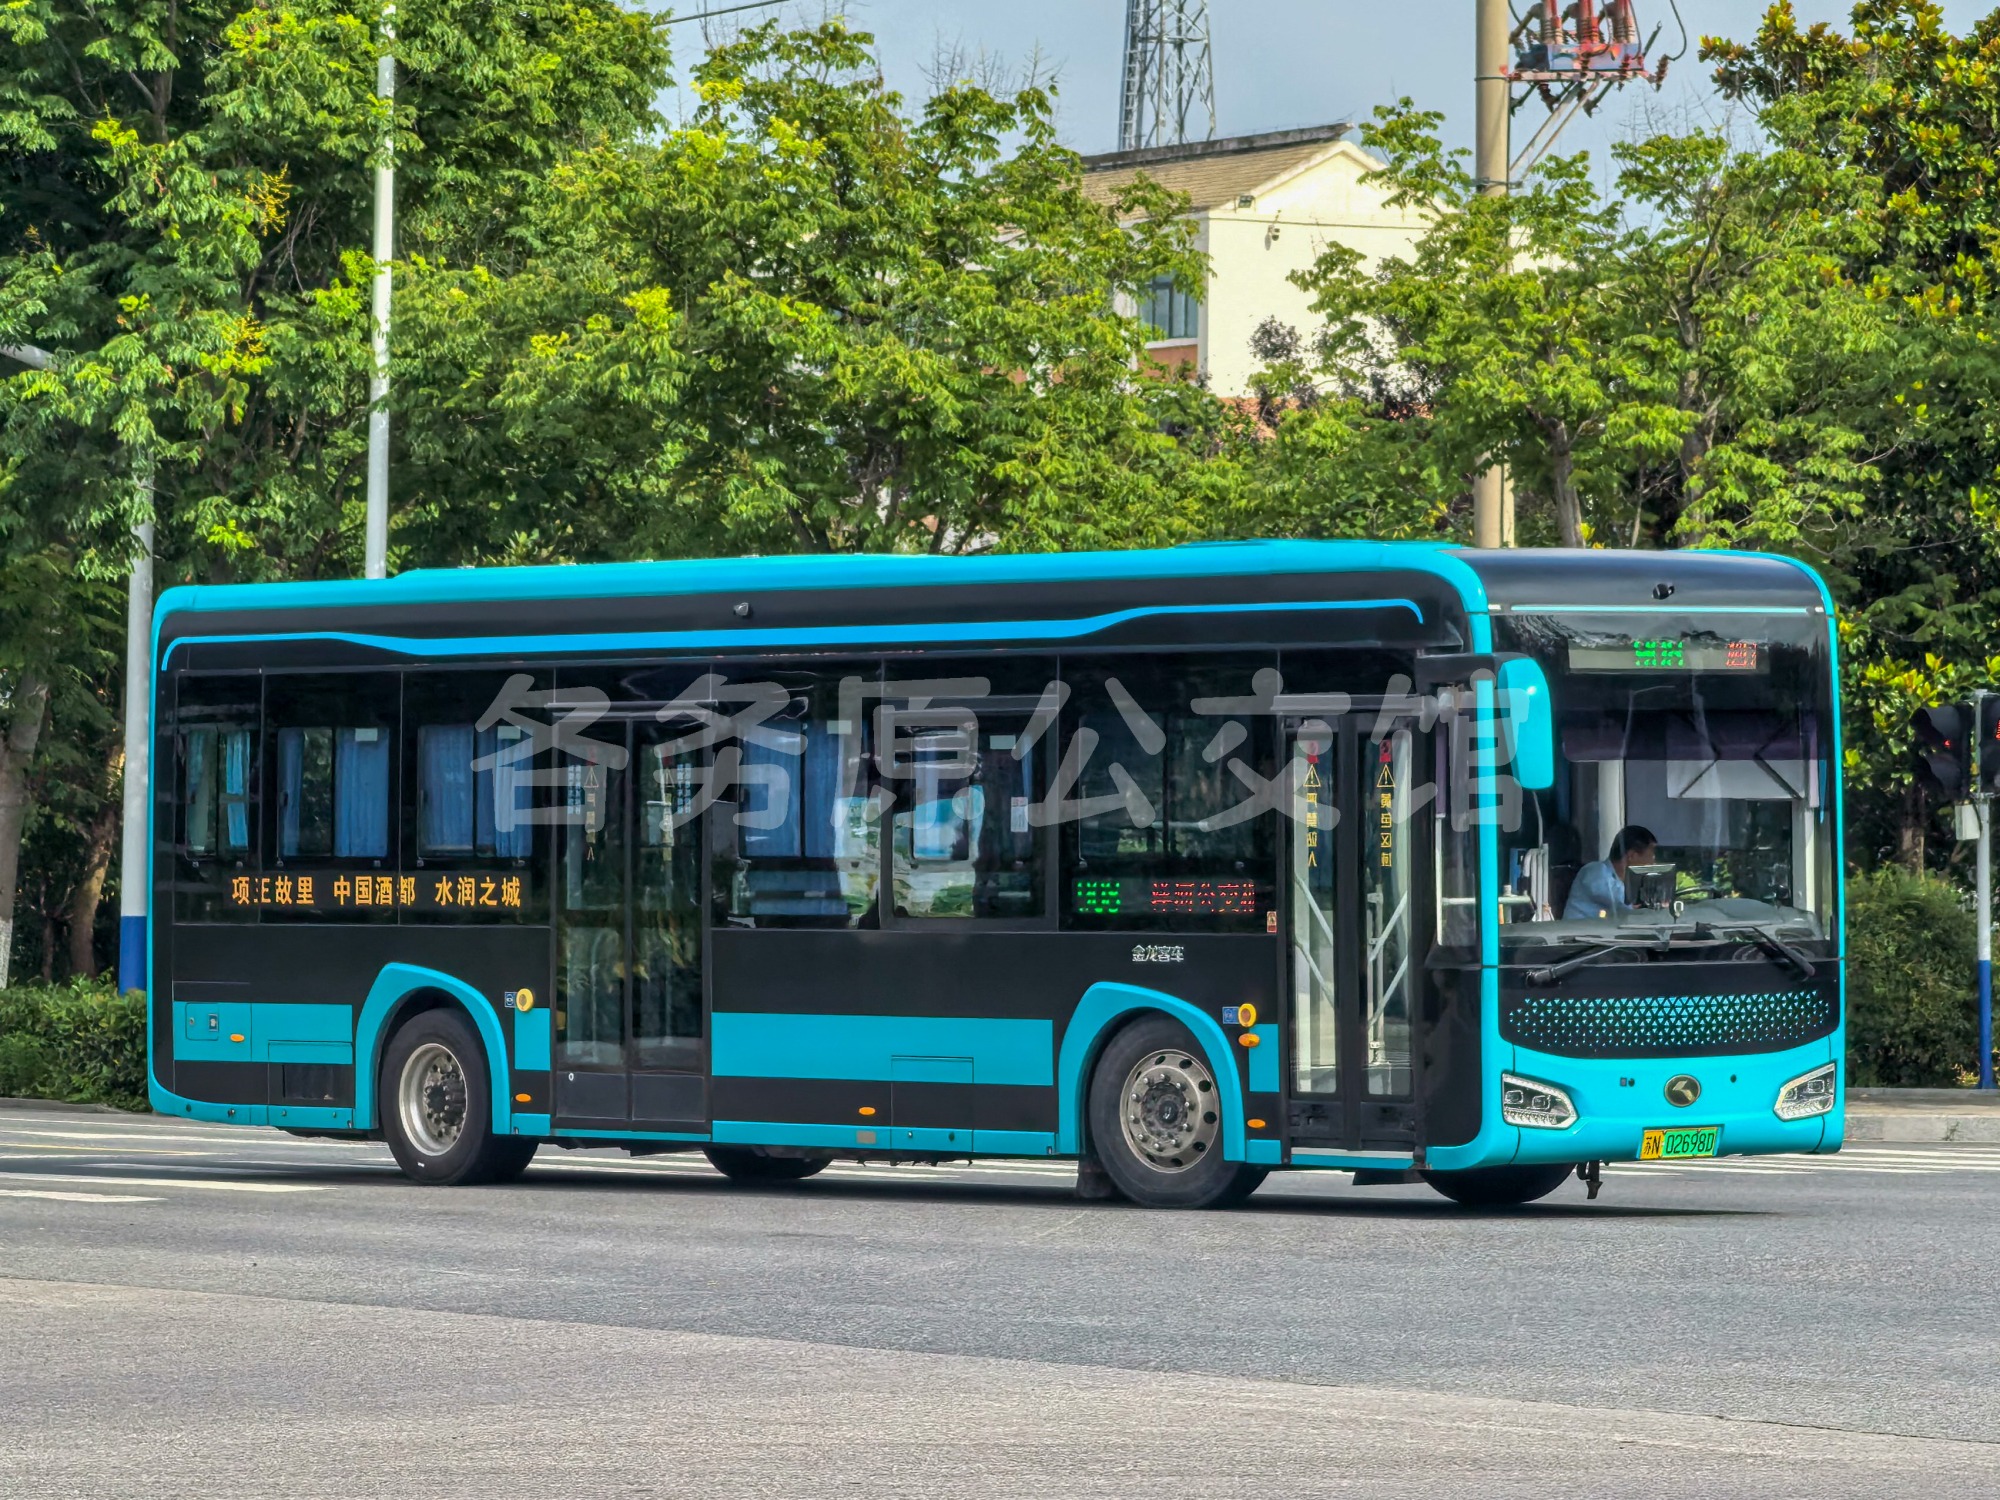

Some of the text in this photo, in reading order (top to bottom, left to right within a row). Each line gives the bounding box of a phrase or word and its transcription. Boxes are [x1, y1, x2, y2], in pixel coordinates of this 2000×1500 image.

[232, 875, 521, 907] 项王故里 中国酒都 水润之城
[1131, 944, 1185, 962] 金龙客车
